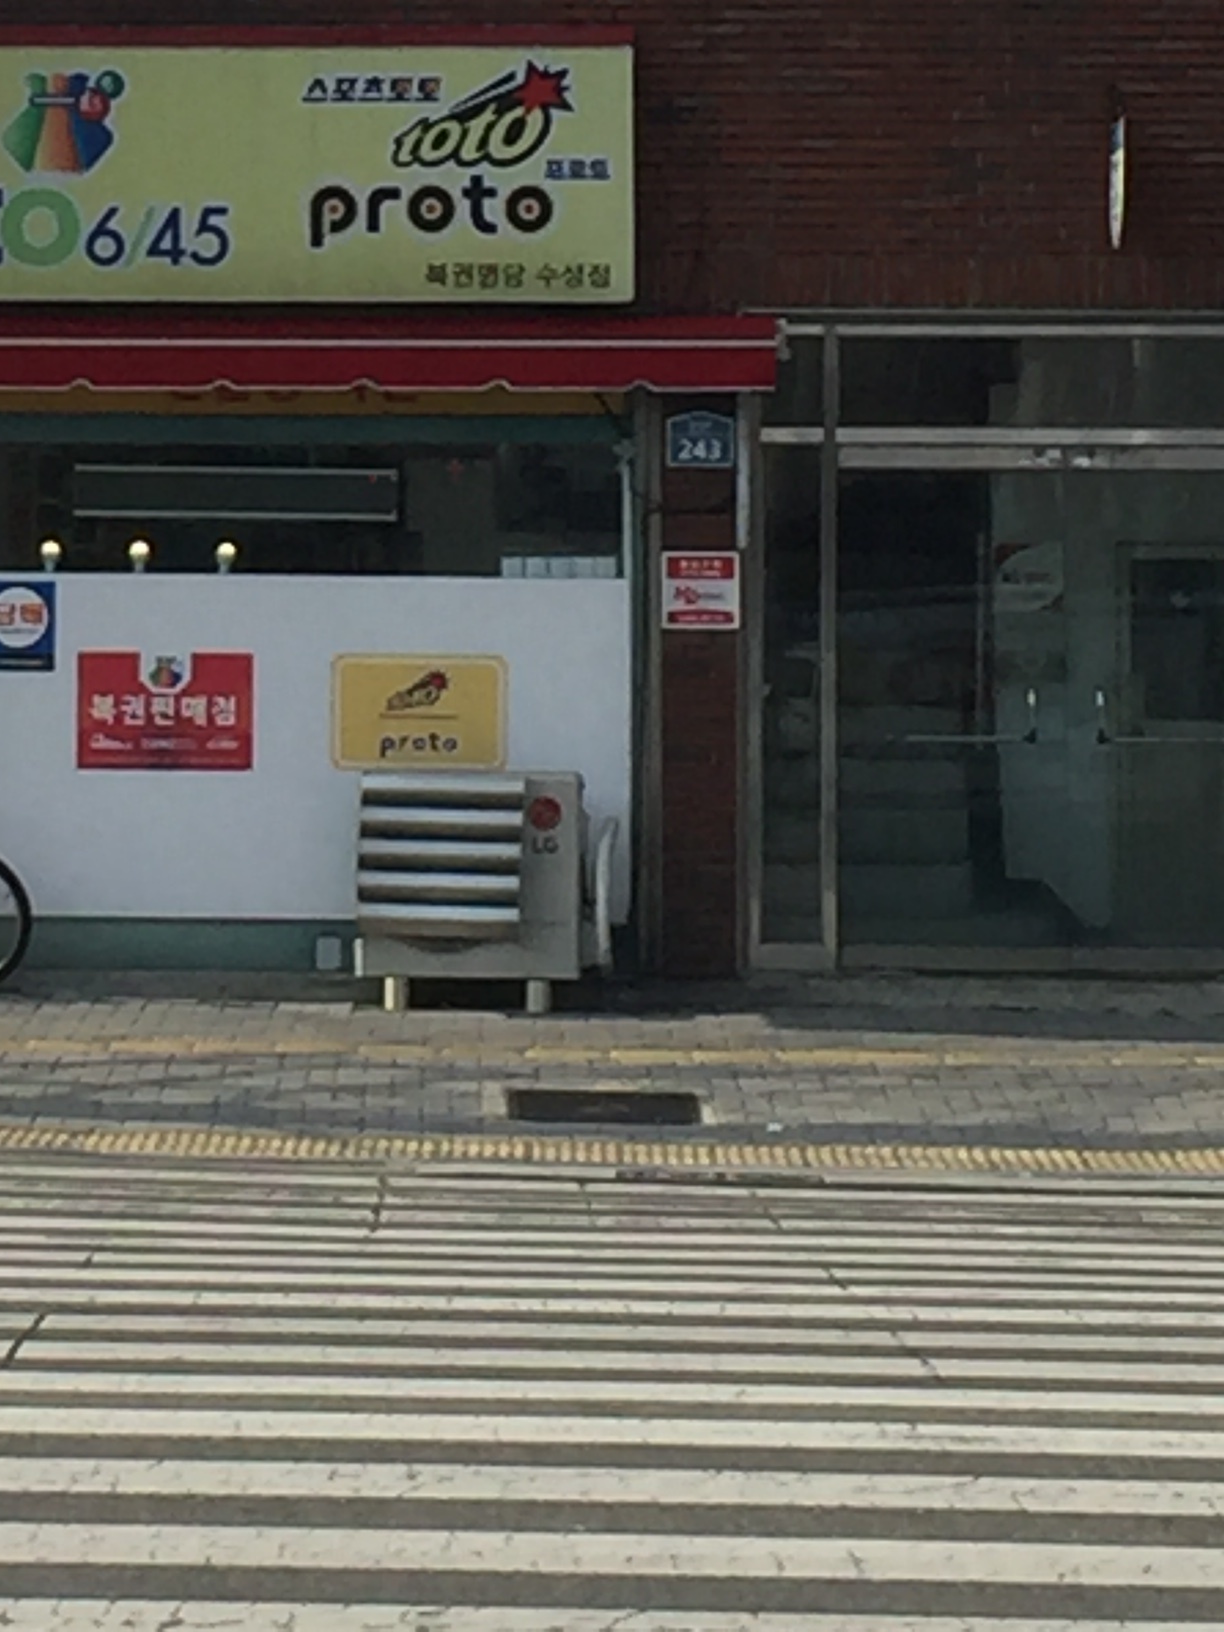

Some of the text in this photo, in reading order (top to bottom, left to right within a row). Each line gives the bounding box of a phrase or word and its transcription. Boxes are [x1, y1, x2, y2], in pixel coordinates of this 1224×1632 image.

[392, 104, 552, 167] toto
[310, 175, 553, 247] proto
[84, 203, 232, 269] 6/45
[425, 262, 526, 288] 복권명당
[678, 438, 723, 460] 243
[380, 732, 459, 759] proto
[532, 836, 560, 855] LG
